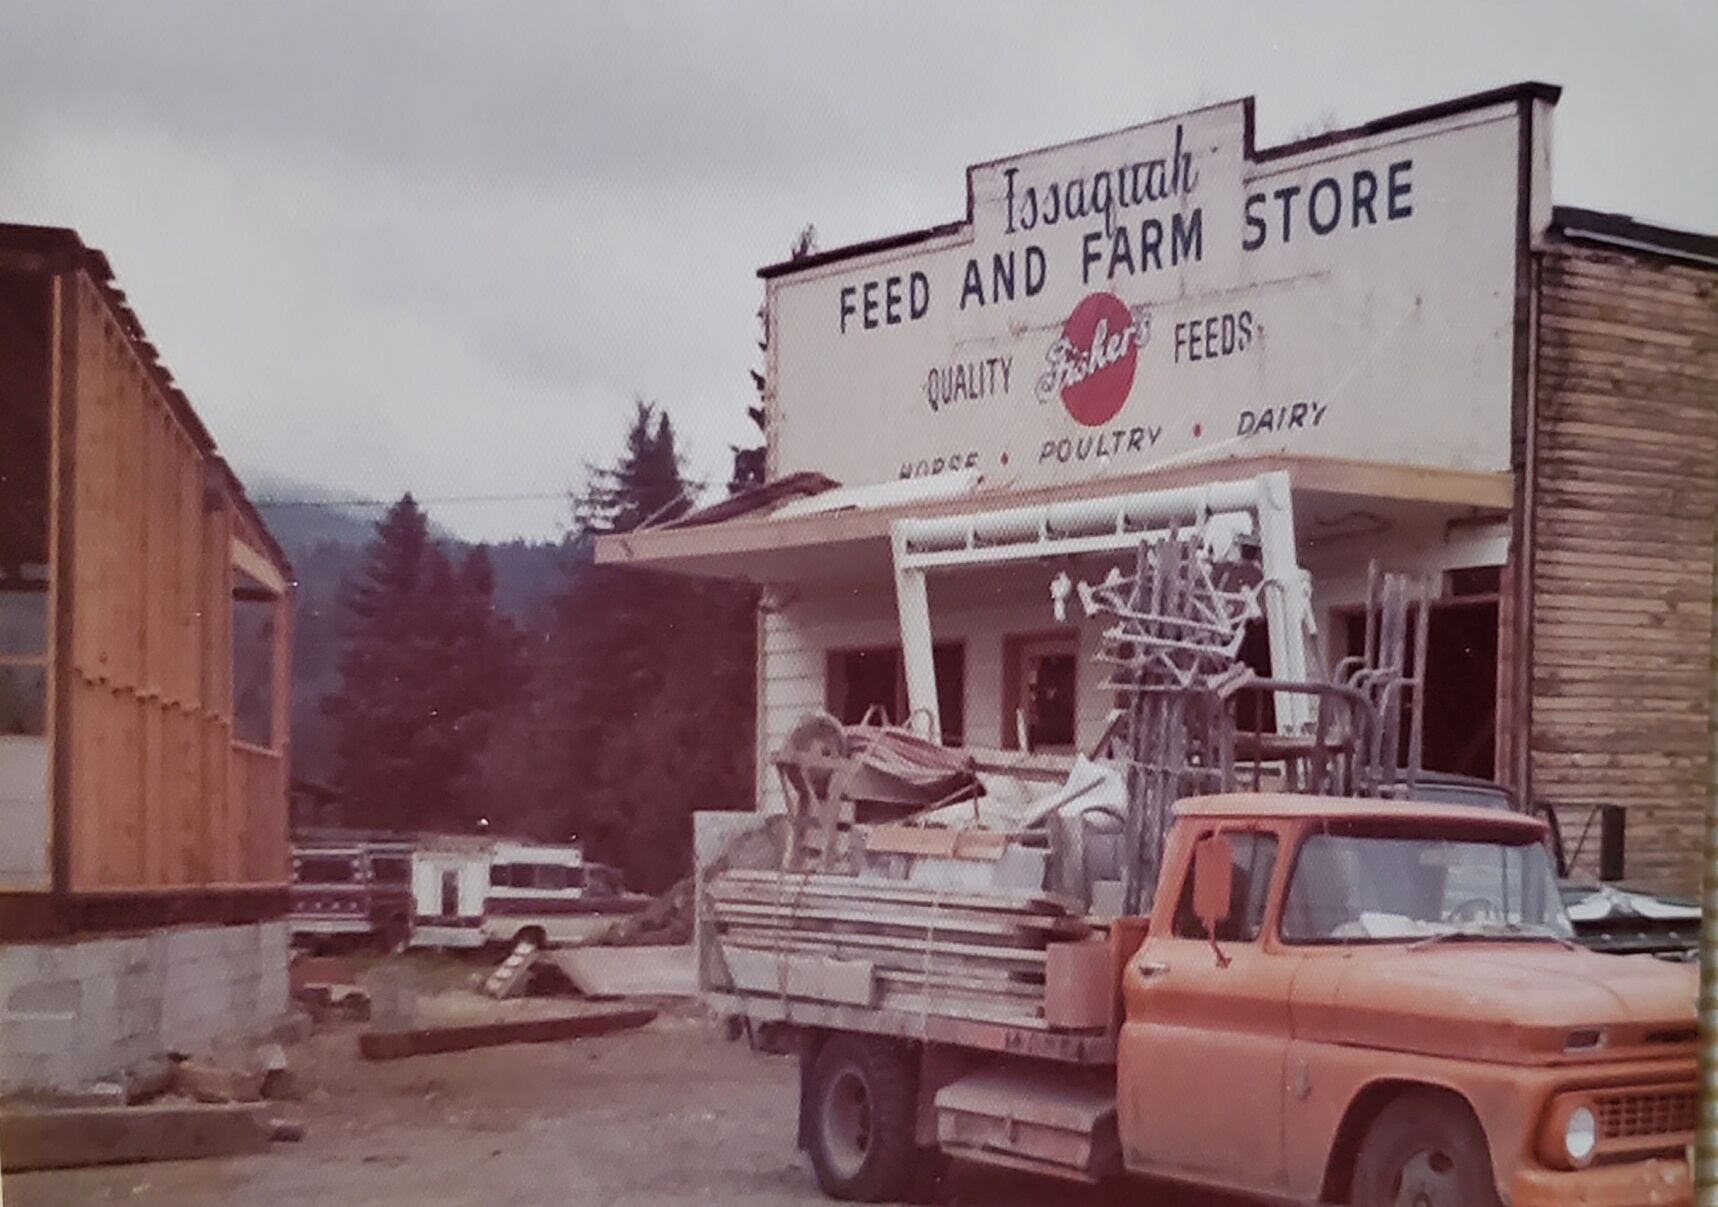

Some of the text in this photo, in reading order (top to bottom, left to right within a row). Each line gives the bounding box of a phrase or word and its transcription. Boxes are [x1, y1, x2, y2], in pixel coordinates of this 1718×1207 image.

[1003, 124, 1199, 241] Issaquah
[840, 159, 1413, 334] FEED AND FARM STORE
[926, 356, 1013, 412] QUALITY
[1173, 310, 1253, 363] FEEDS
[1038, 425, 1162, 465] POULTRY
[1236, 401, 1328, 437] DAIRY
